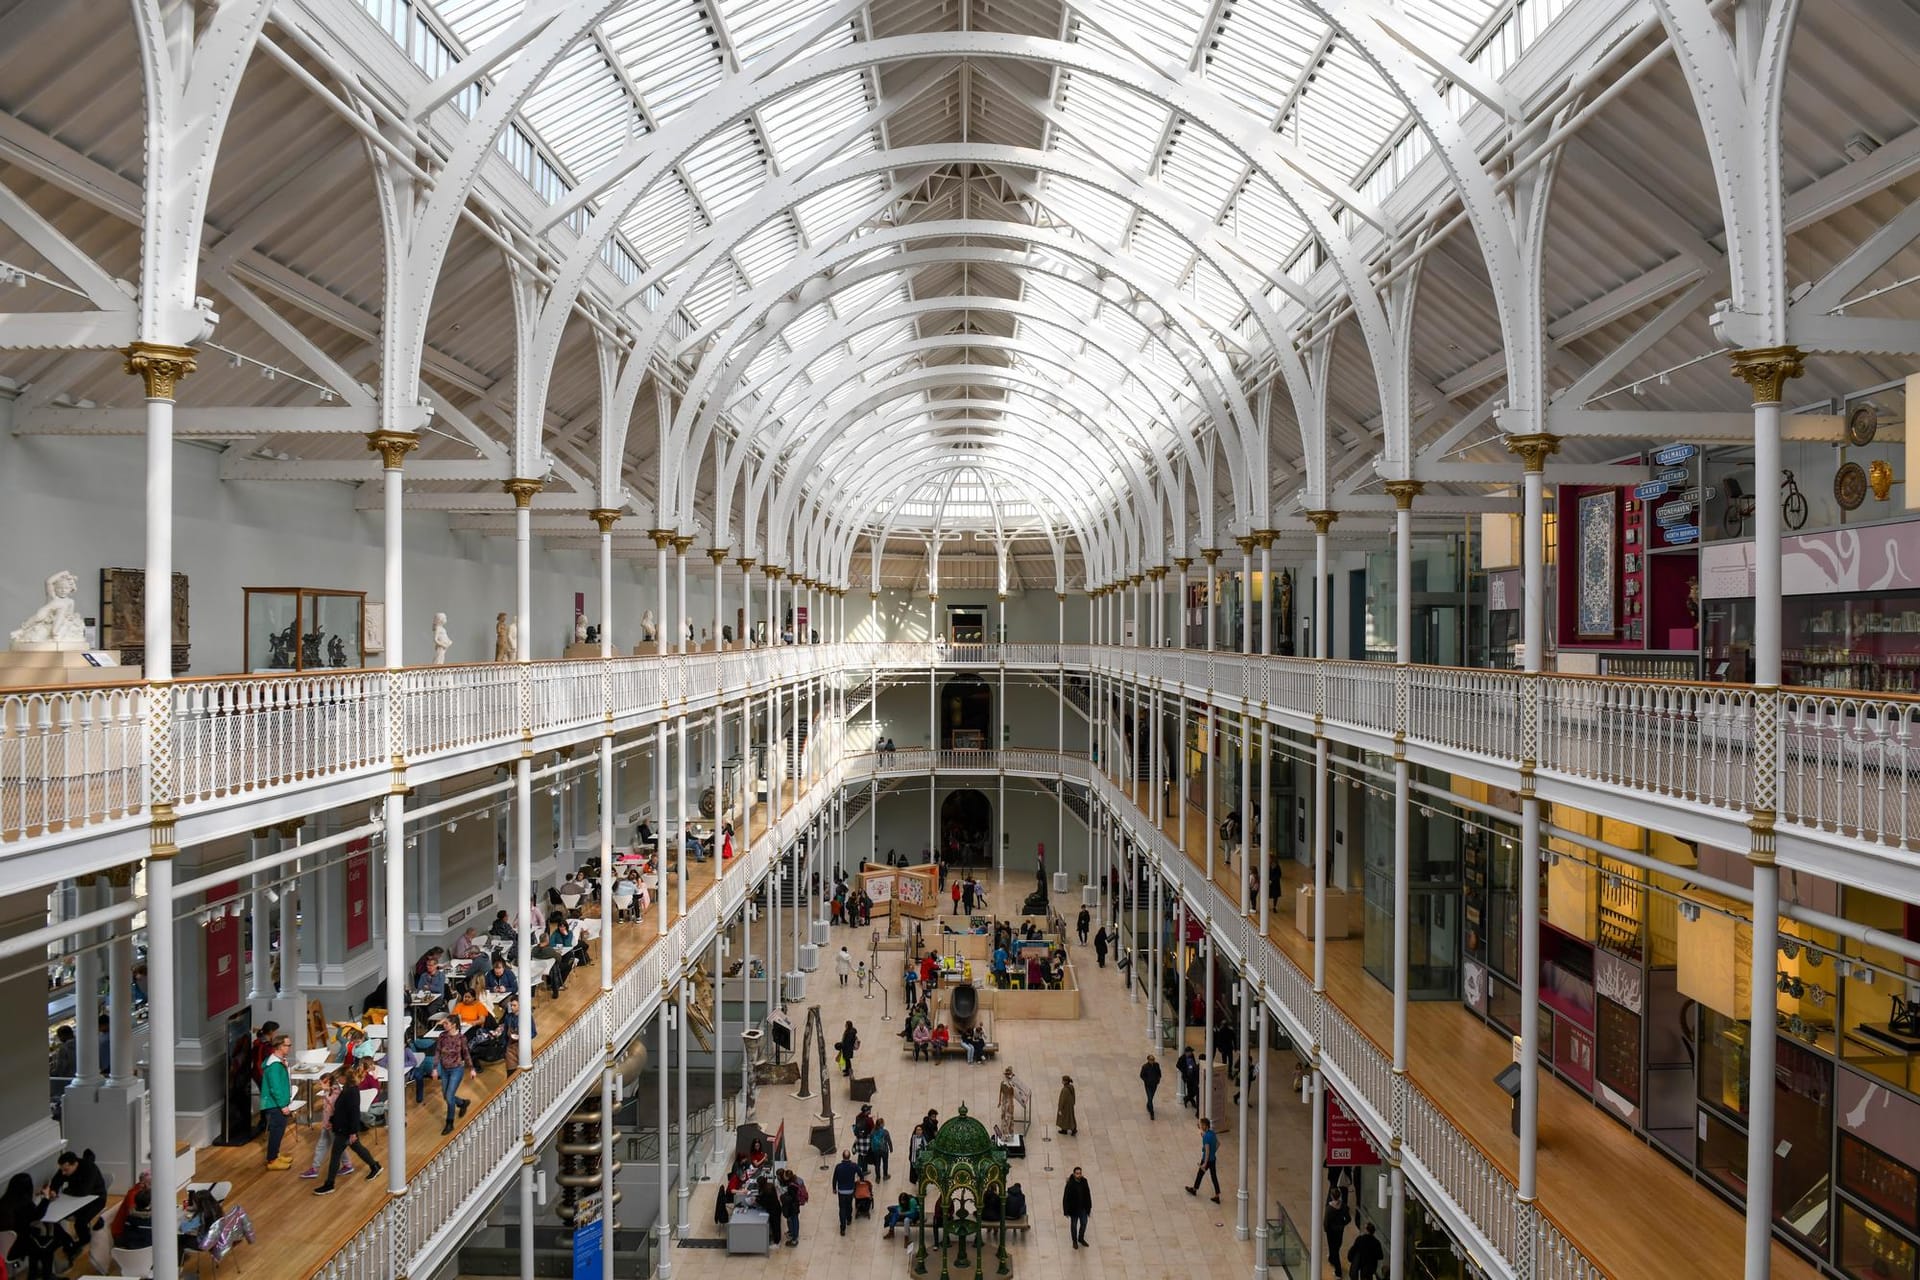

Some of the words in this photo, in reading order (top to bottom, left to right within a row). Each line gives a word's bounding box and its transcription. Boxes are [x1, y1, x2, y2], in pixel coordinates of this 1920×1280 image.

[1641, 486, 1660, 496] GARVE
[1658, 503, 1690, 516] STONEHAVEN
[1333, 1150, 1349, 1158] Exit
